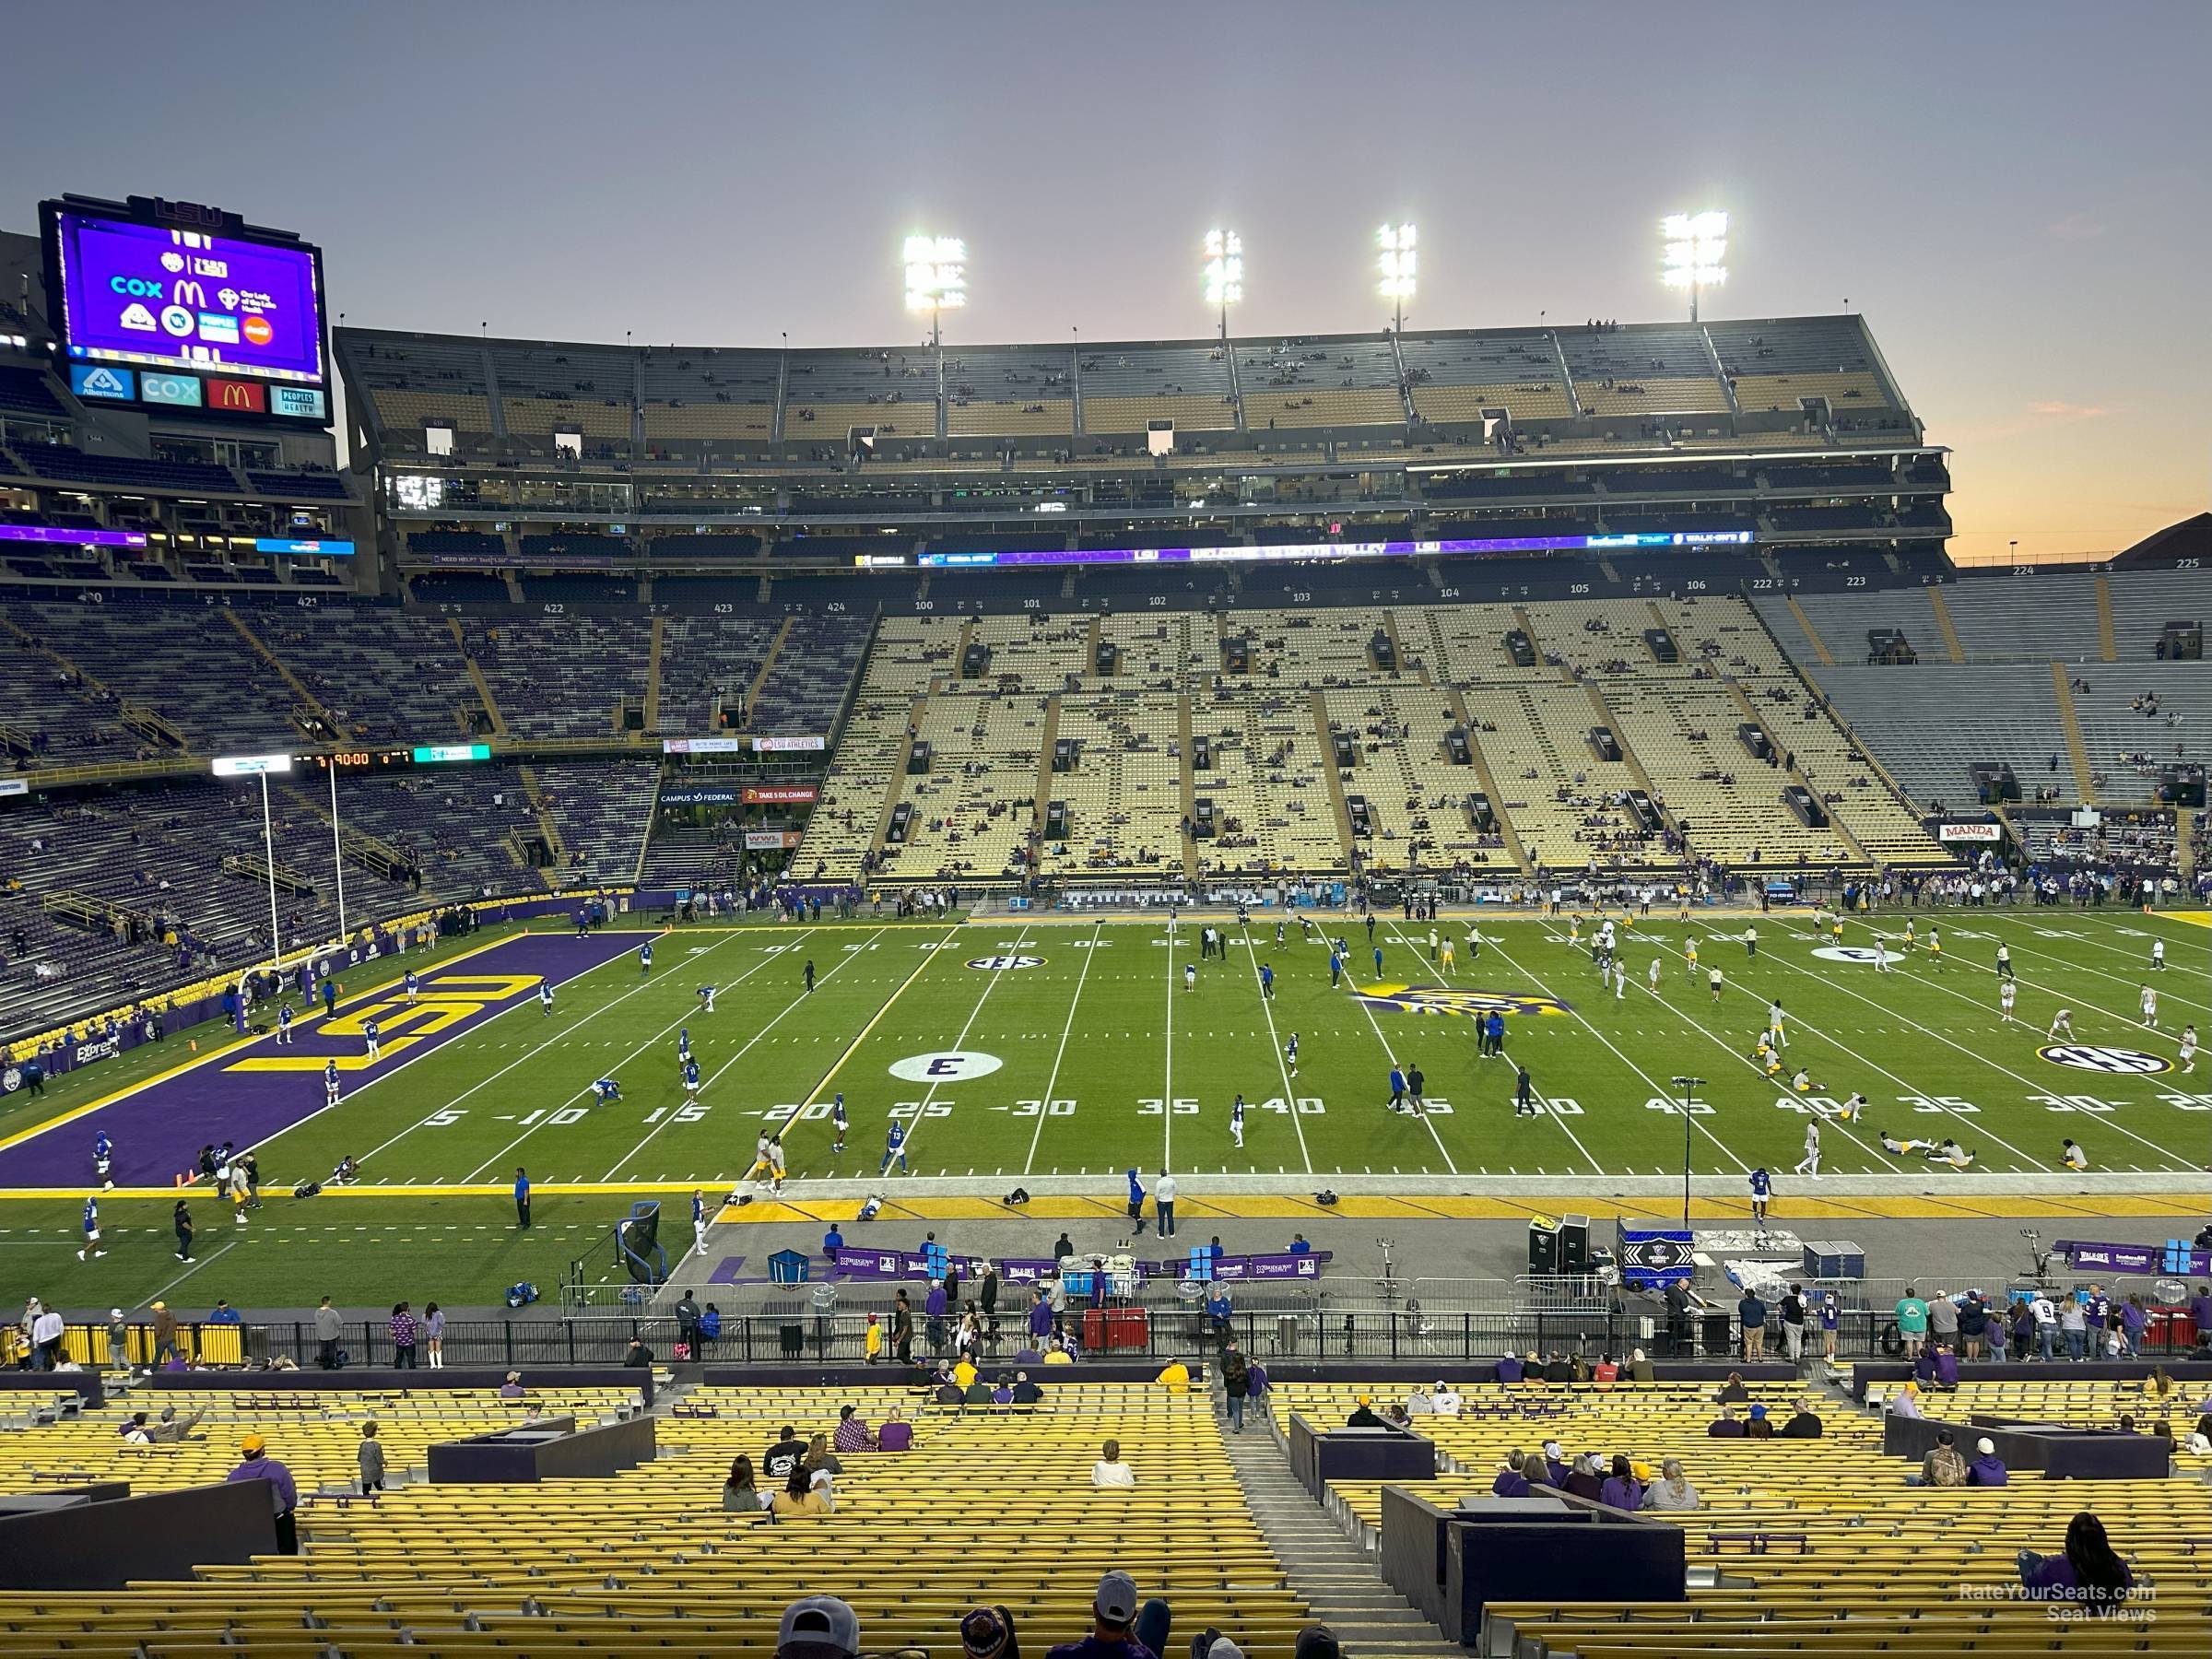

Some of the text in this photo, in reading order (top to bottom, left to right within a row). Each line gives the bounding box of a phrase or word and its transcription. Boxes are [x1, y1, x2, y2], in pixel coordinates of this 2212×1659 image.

[154, 196, 222, 227] LSU
[111, 276, 162, 299] COX
[83, 387, 124, 398] Albertsons
[143, 378, 200, 401] COX
[283, 391, 313, 404] PEOPLES
[284, 403, 313, 414] HEALTH
[1135, 549, 1159, 560] LSU
[1333, 543, 1386, 557] VALLEY
[2176, 559, 2199, 569] 225
[2013, 566, 2034, 576] 224
[1687, 581, 1706, 590] 106
[1753, 580, 1772, 589] 222
[1846, 576, 1865, 586] 223
[1441, 588, 1460, 598] 104
[1571, 584, 1589, 594] 105
[298, 596, 317, 607] 421
[1148, 596, 1166, 606] 102
[1293, 593, 1311, 602] 103
[544, 604, 563, 613] 422
[714, 604, 733, 613] 423
[828, 603, 845, 612] 424
[915, 601, 934, 610] 100
[1023, 599, 1041, 608] 101
[335, 753, 369, 765] 90:00
[382, 756, 389, 764] 0
[1946, 825, 1994, 837] MANDA
[219, 974, 546, 1072] LSU
[1012, 1100, 1077, 1116] 30
[1136, 1099, 1200, 1115] 35
[1260, 1098, 1326, 1114] 40
[1644, 1097, 1718, 1114] 45
[1775, 1097, 1847, 1113] 40
[1896, 1096, 1983, 1112] 35
[2026, 1095, 2116, 1112] 30
[642, 1106, 712, 1124] 15
[761, 1103, 835, 1121] 20
[887, 1101, 956, 1118] 25
[424, 1110, 469, 1126] 5
[518, 1108, 590, 1125] 10
[892, 1131, 902, 1140] 13
[846, 1257, 875, 1266] BRIDGEWAY
[2079, 1251, 2110, 1264] WALK-ON'S
[1009, 1267, 1035, 1278] WALK-ON'S
[2041, 1305, 2052, 1317] 9
[2098, 1305, 2108, 1316] 35
